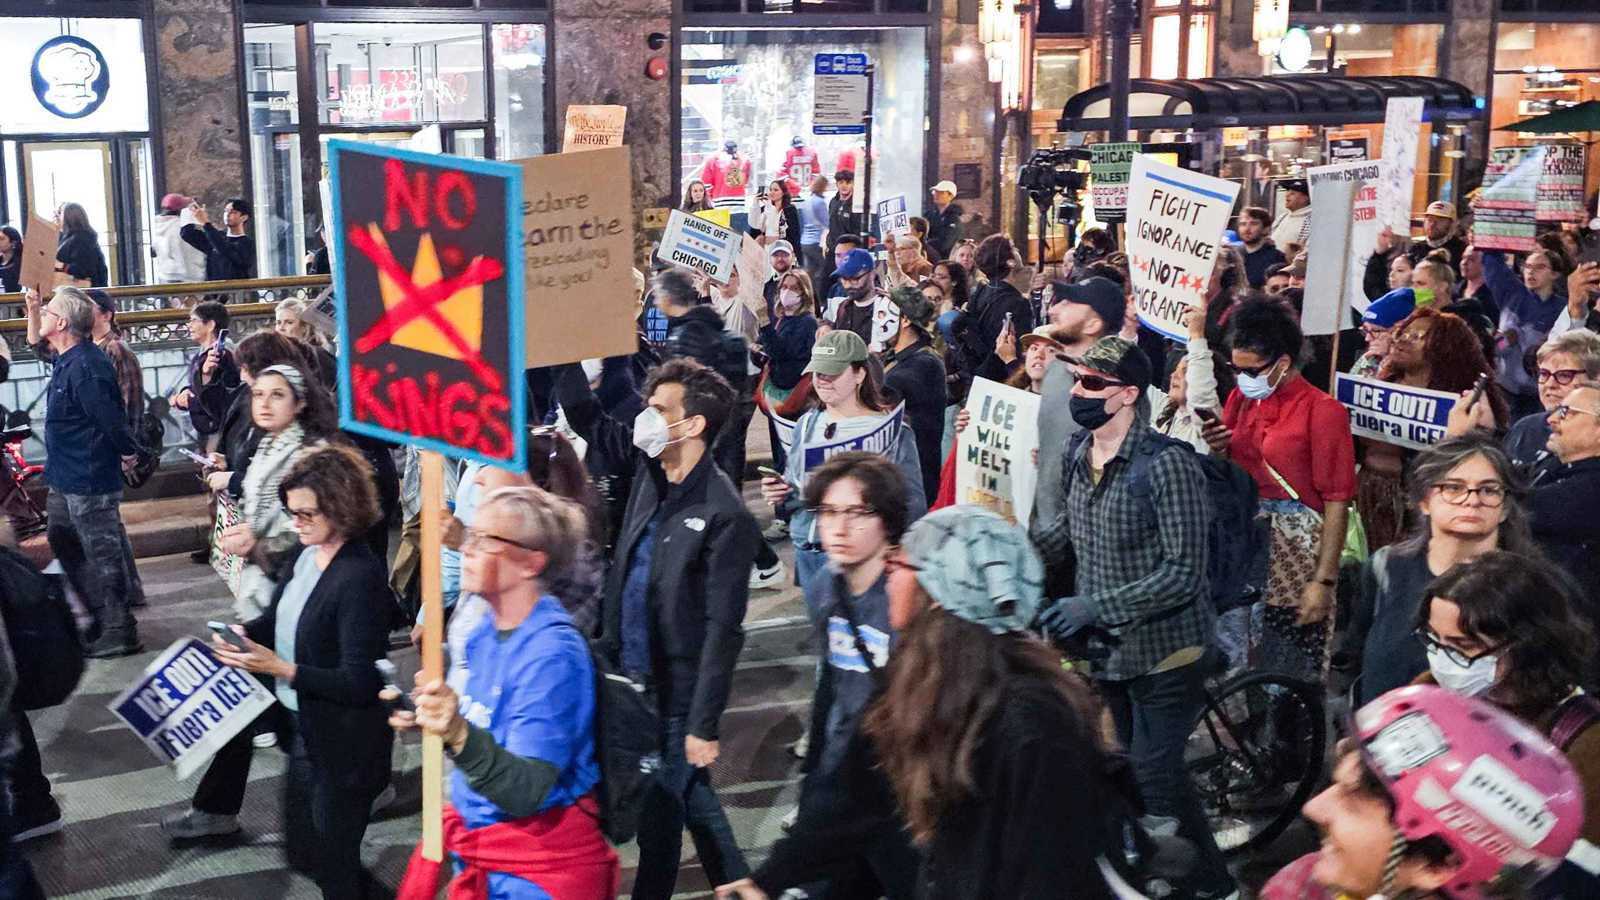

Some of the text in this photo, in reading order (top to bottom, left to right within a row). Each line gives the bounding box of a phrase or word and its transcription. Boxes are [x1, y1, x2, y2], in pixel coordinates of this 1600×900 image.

[573, 134, 610, 145] HISTORY
[1563, 147, 1583, 158] THE
[1344, 165, 1379, 181] CHICAGO
[383, 158, 476, 232] NO
[1150, 189, 1207, 226] FIGHT
[523, 216, 624, 247] arn the
[683, 217, 729, 241] HANDS OFF
[1137, 219, 1214, 261] IGNORANCE
[672, 250, 718, 275] CHICAGO
[1148, 257, 1185, 288] NOT
[980, 395, 1016, 430] ICE
[1353, 384, 1437, 423] ICE OUT!
[977, 425, 1011, 450] WILL
[967, 444, 1011, 475] MELT
[981, 473, 997, 491] IN
[134, 647, 219, 722] ICE OUT!
[210, 668, 255, 711] ICE!
